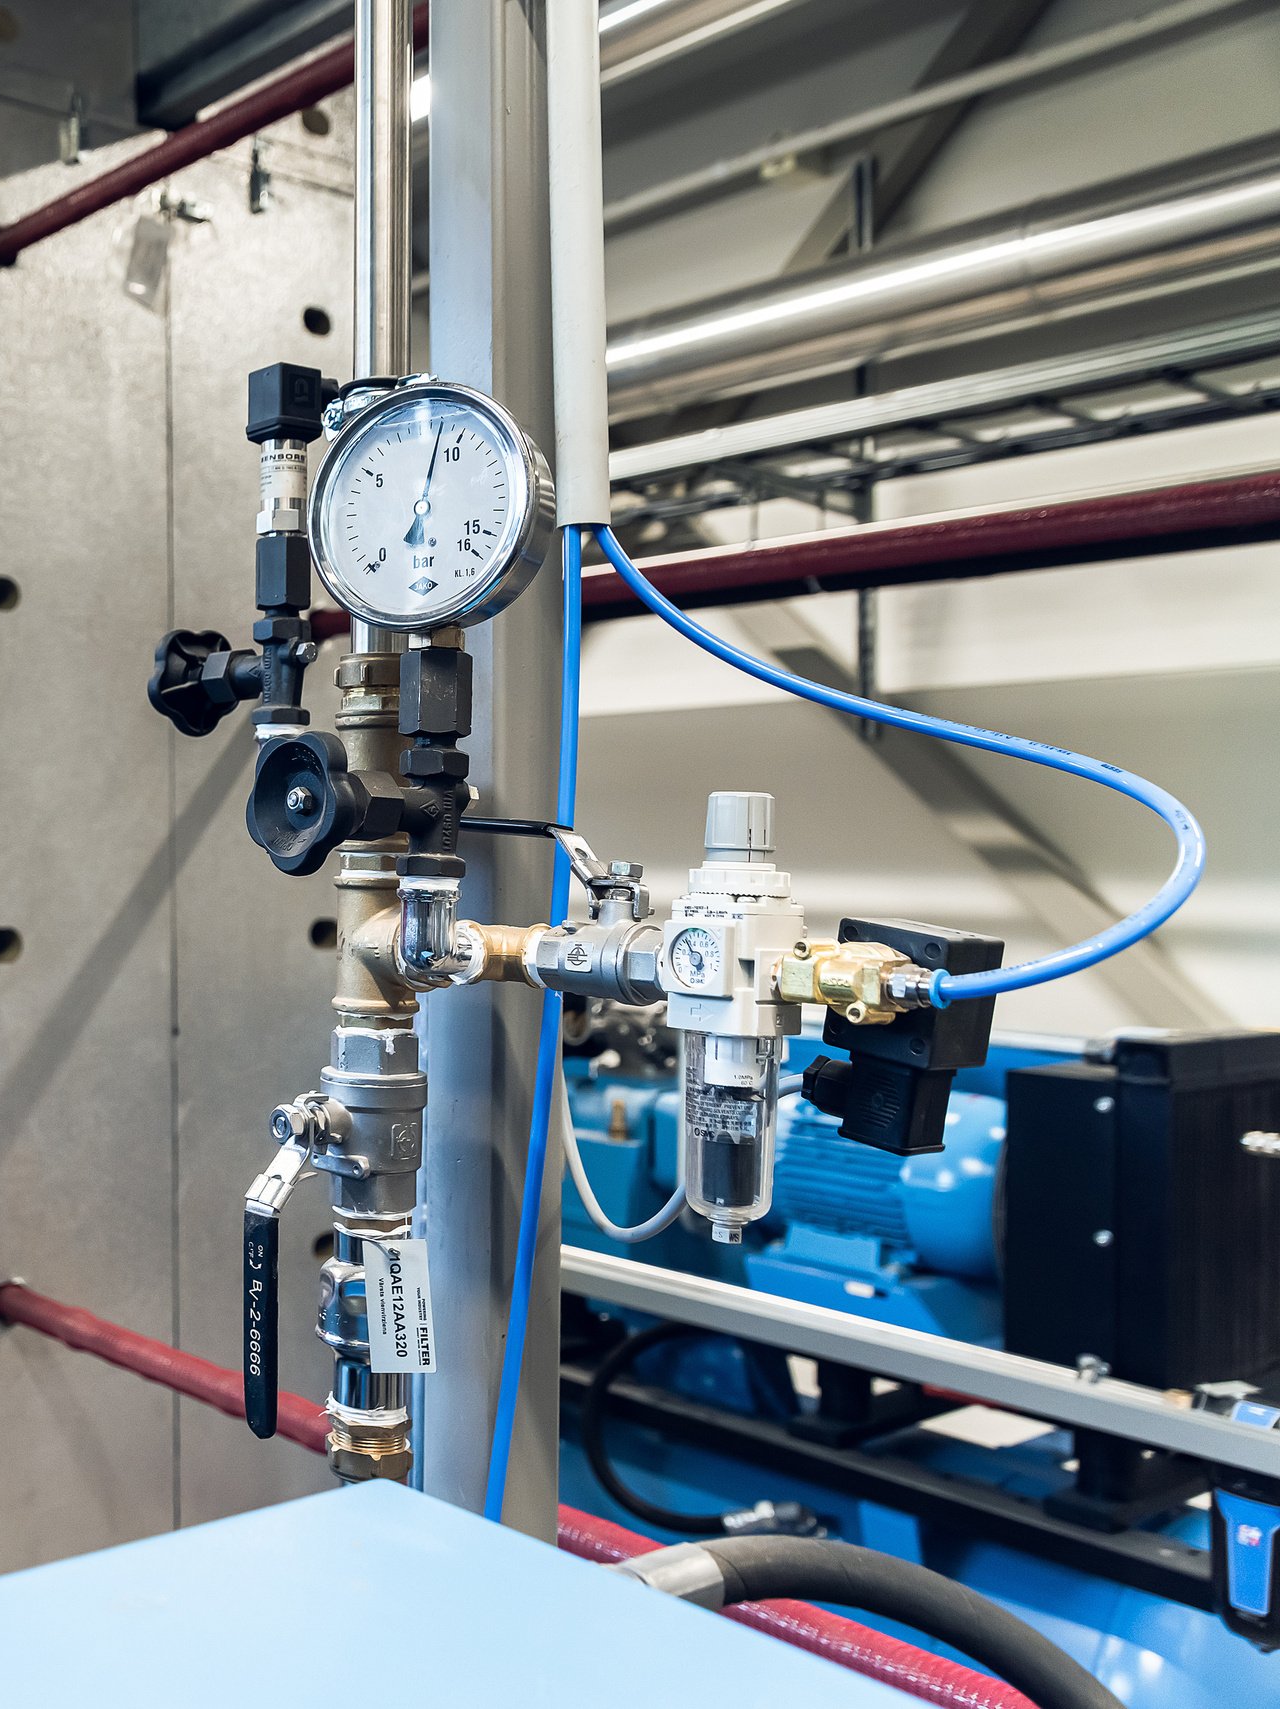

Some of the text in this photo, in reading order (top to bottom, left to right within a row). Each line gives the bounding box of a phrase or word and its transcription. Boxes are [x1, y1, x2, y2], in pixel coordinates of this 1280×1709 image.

[443, 446, 460, 463] 10
[375, 473, 384, 488] 5
[463, 519, 481, 535] 15
[456, 538, 471, 552] 16
[378, 547, 387, 562] 0
[413, 555, 435, 569] bar
[420, 1327, 430, 1366] FILTER
